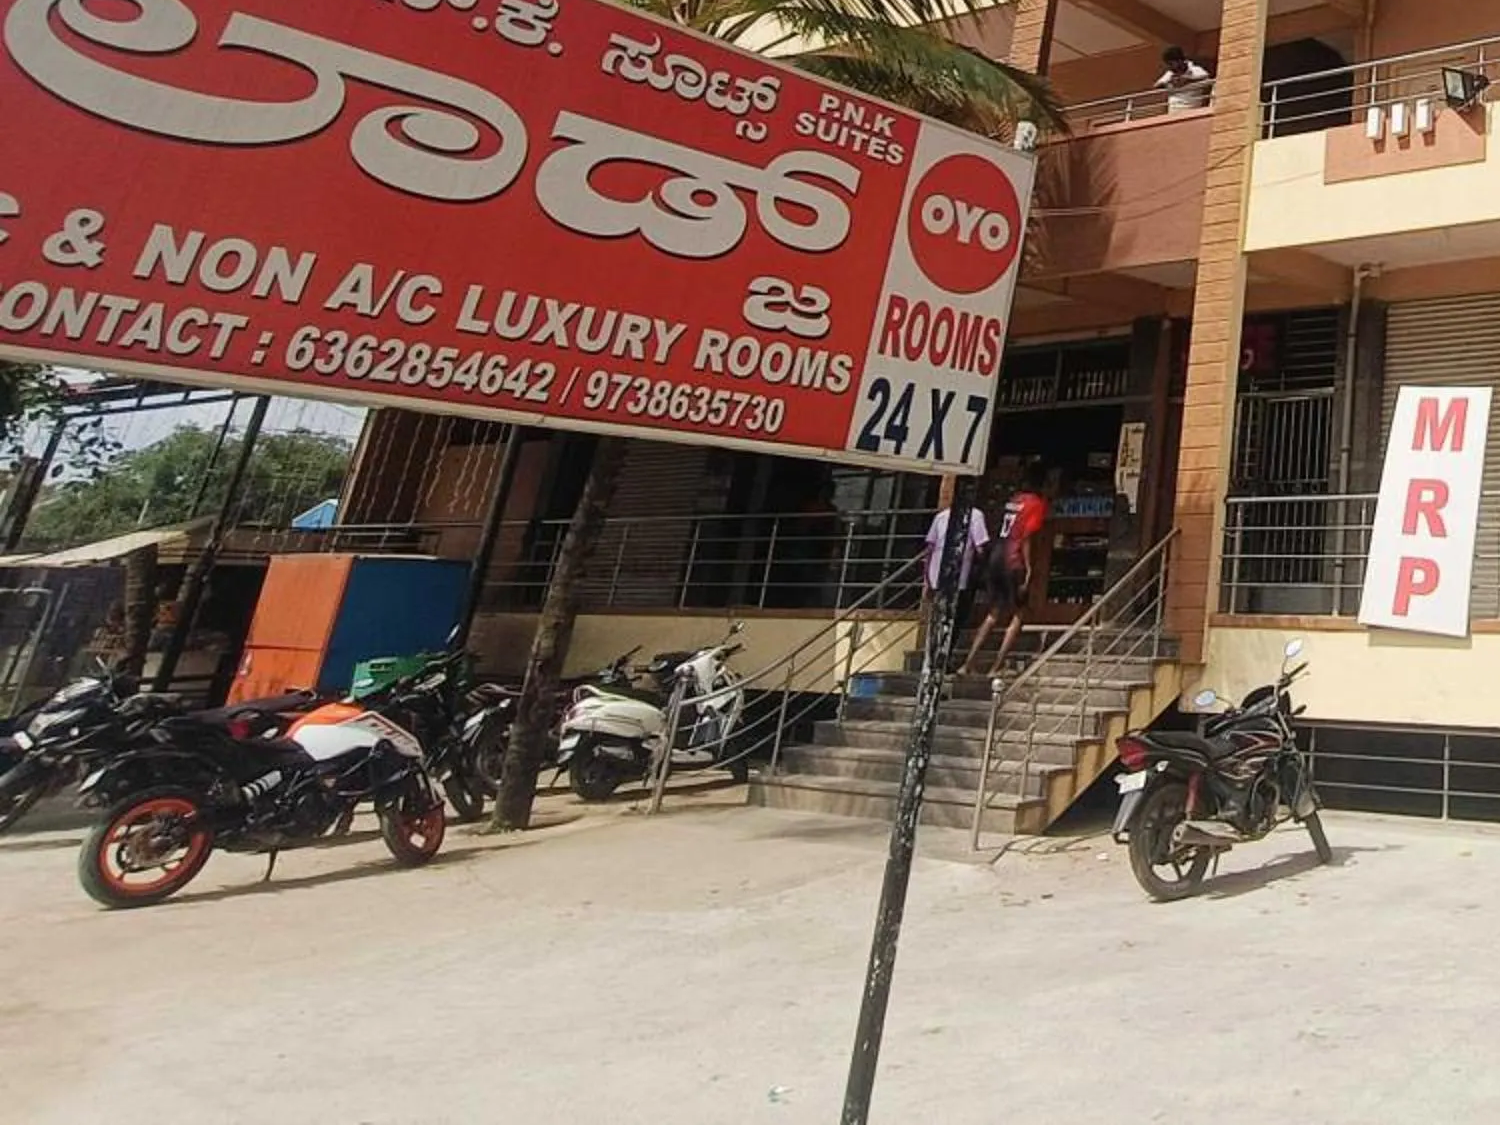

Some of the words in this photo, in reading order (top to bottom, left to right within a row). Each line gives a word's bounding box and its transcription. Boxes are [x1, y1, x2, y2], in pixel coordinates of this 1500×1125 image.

[795, 112, 905, 165] SUITES
[921, 194, 1010, 252] OYO
[42, 208, 106, 268] &
[133, 223, 316, 304] NON
[324, 262, 443, 325] A/C
[456, 283, 687, 365] LUXURY
[694, 328, 853, 393] ROOMS
[878, 294, 1000, 376] ROOMS
[0, 280, 249, 359] ONTACT
[285, 325, 556, 403] 6362854642
[583, 369, 785, 434] 9738635730
[855, 377, 916, 456] 24
[959, 394, 988, 464] 7
